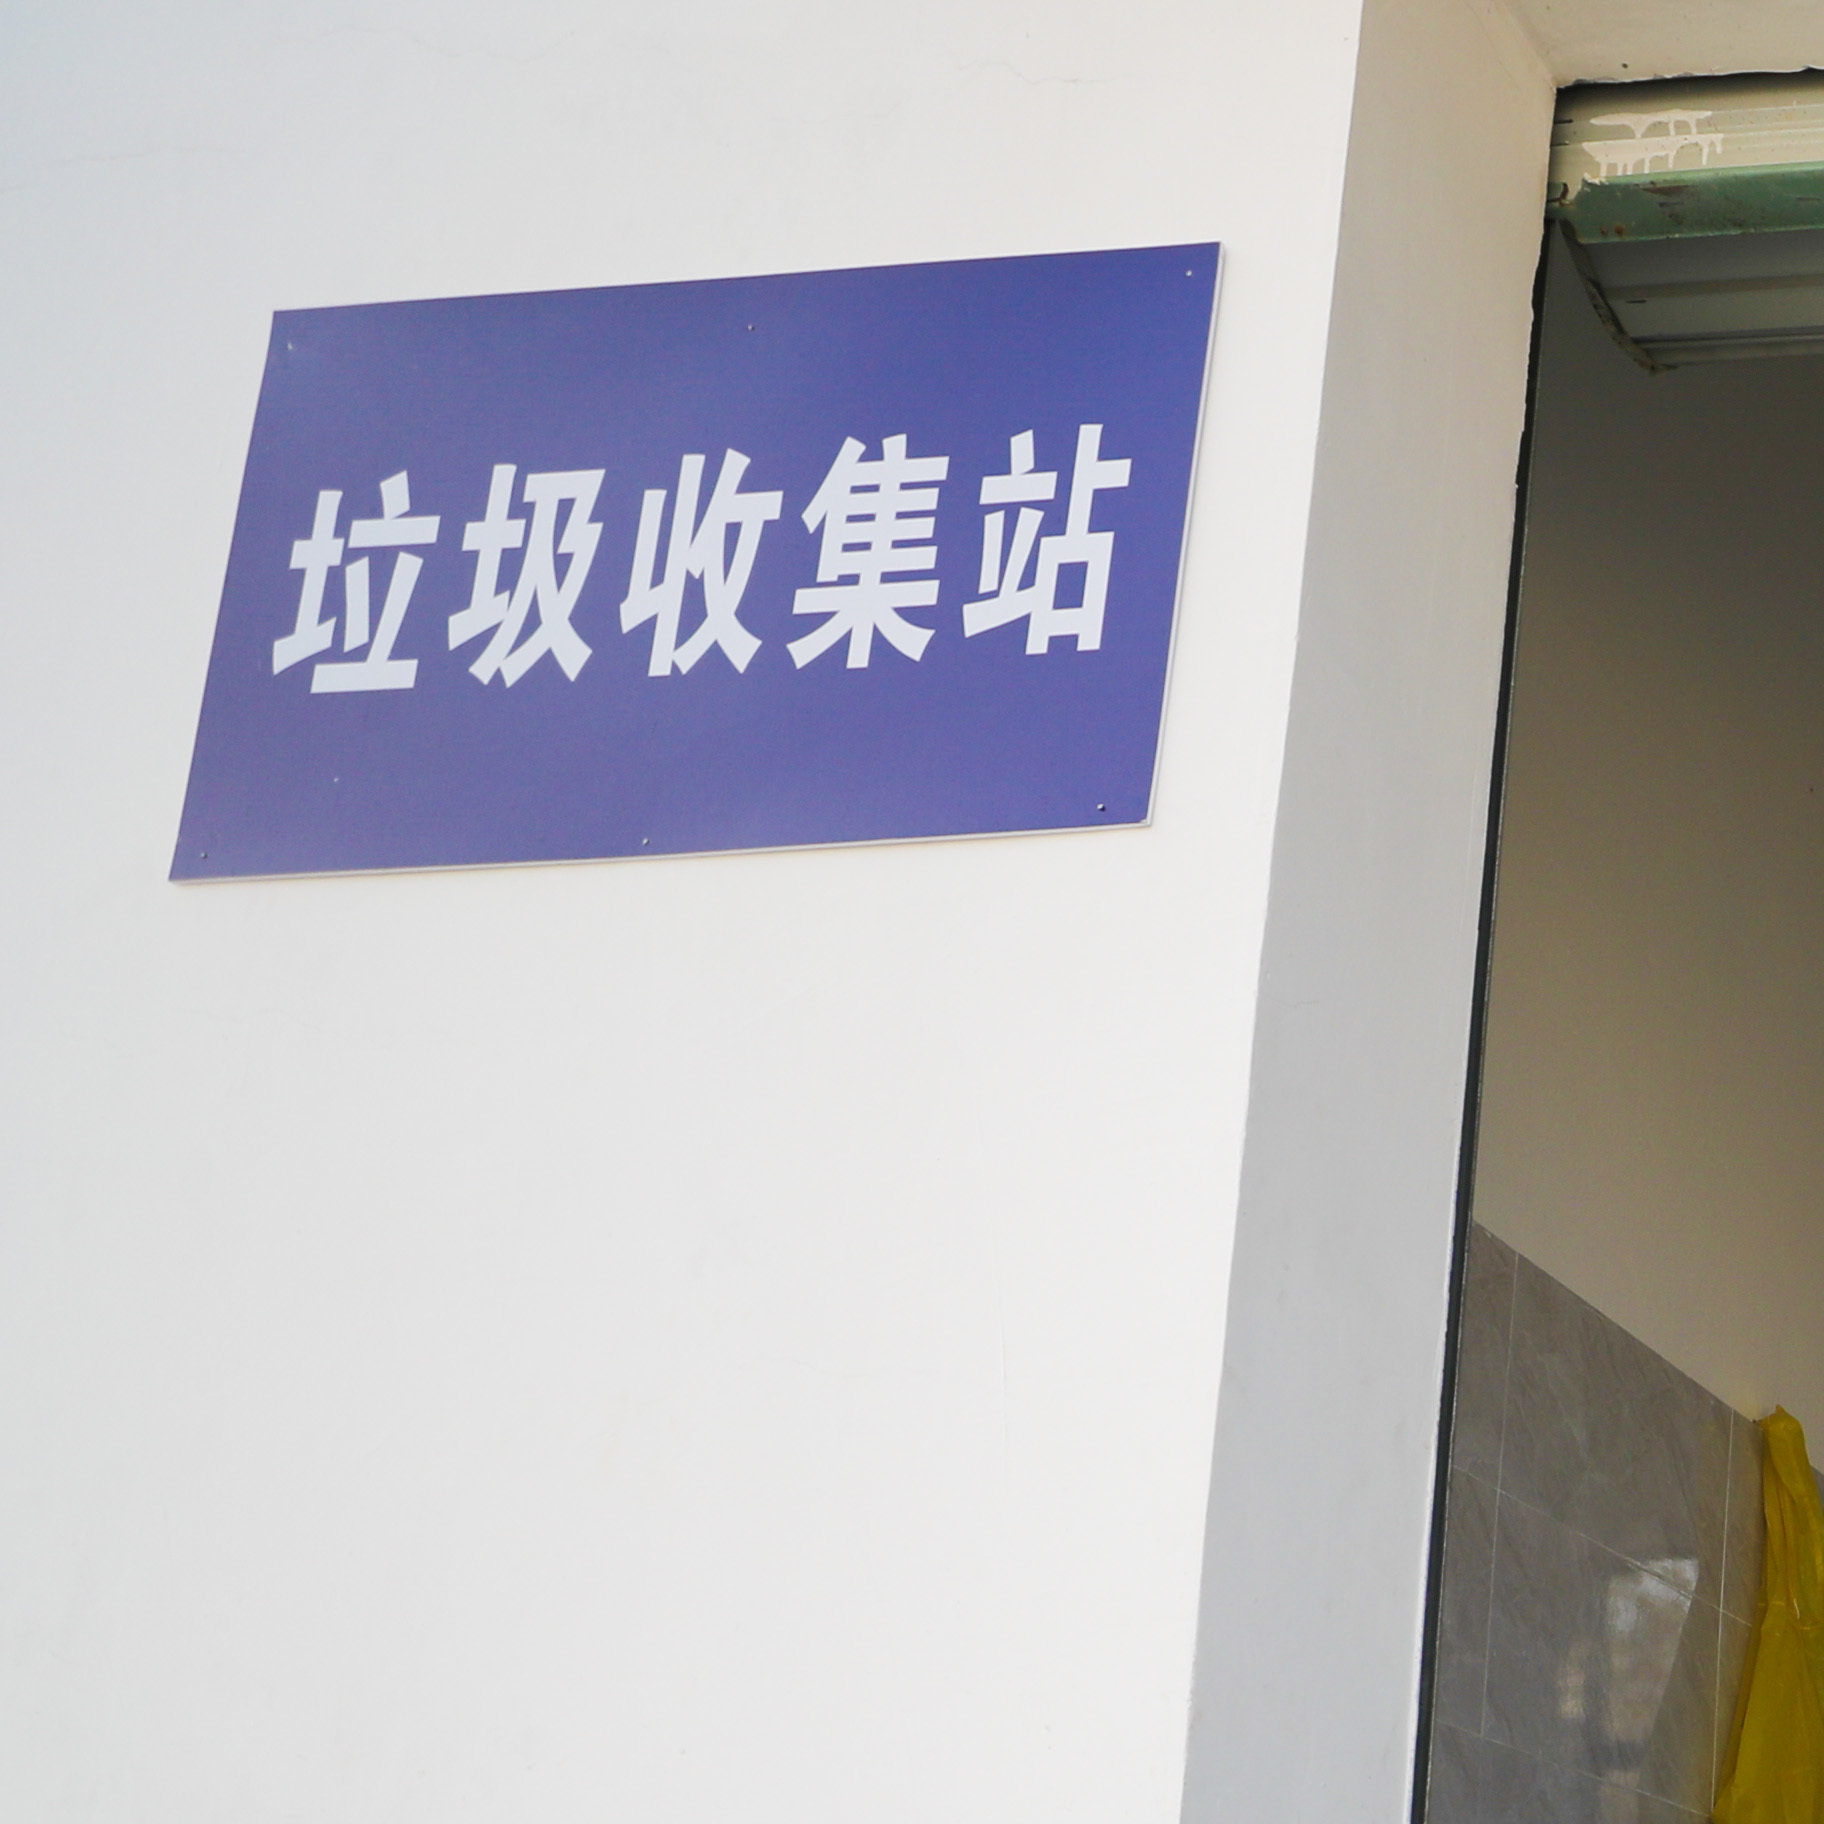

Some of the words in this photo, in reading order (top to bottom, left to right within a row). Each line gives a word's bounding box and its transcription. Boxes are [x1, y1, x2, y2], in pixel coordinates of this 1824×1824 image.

[272, 423, 1133, 694] 垃圾收集站
